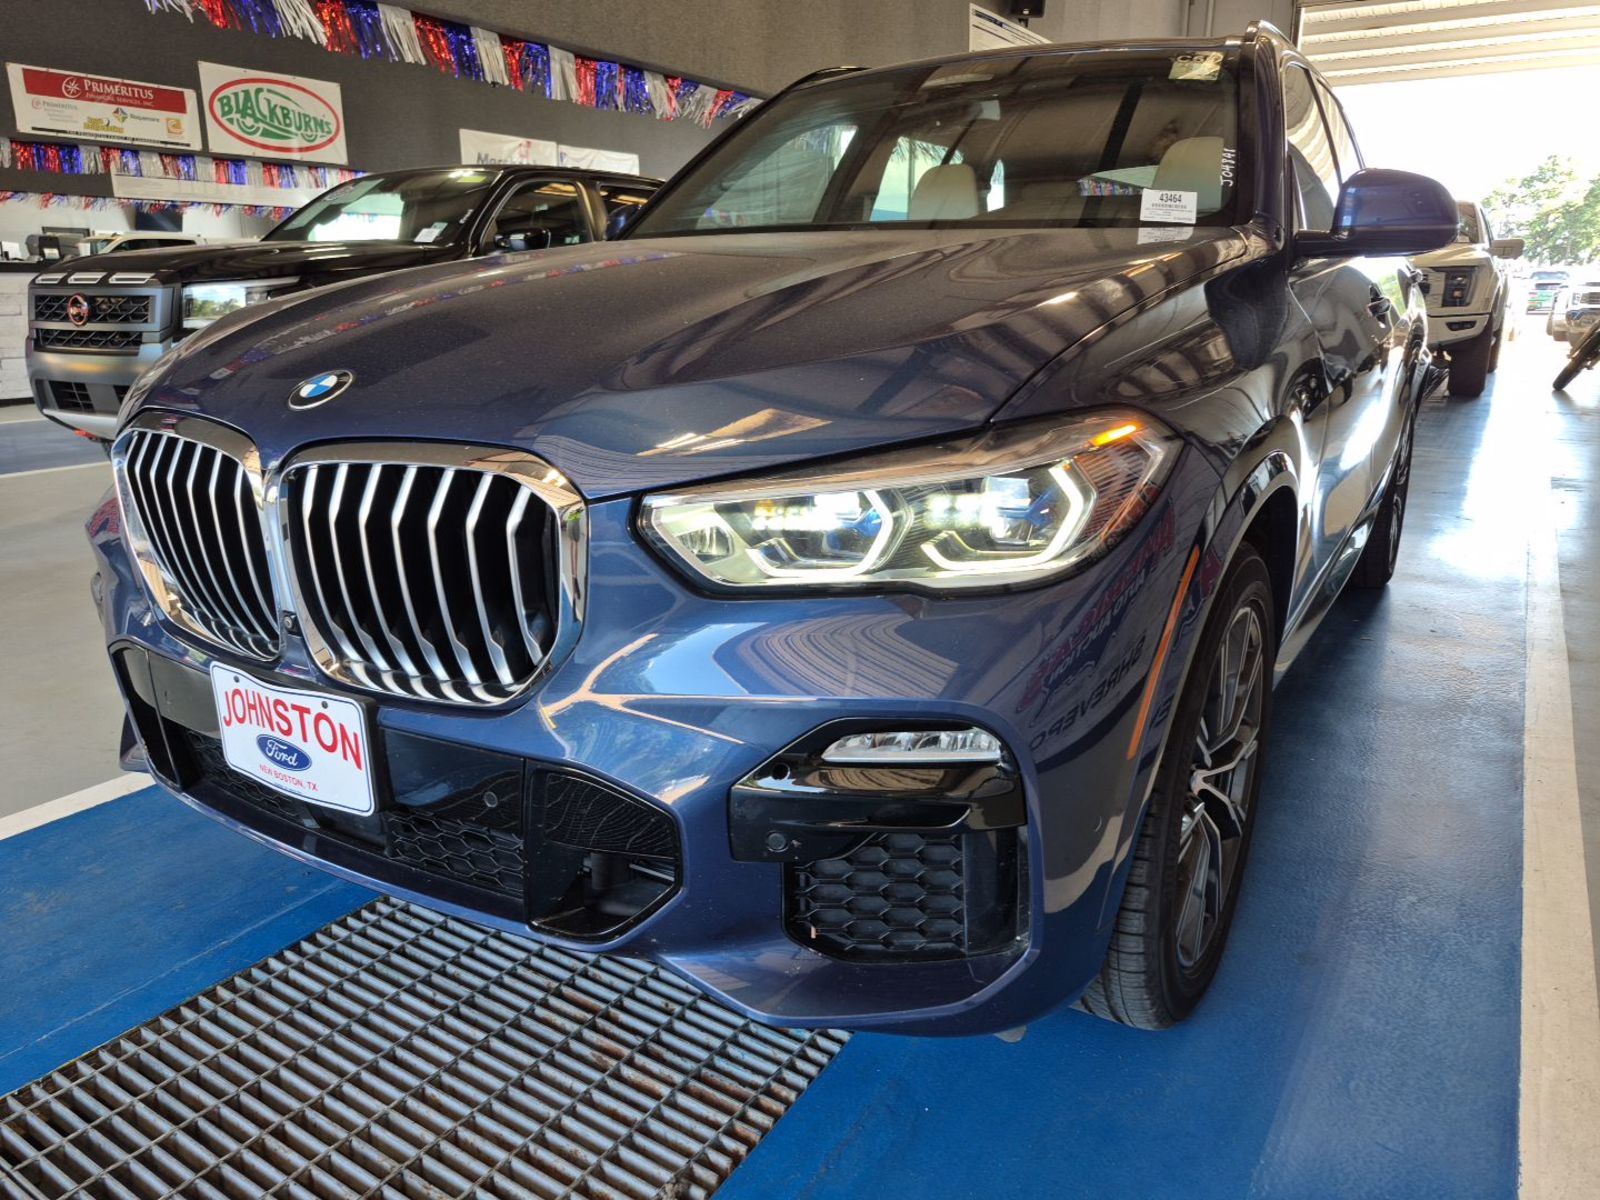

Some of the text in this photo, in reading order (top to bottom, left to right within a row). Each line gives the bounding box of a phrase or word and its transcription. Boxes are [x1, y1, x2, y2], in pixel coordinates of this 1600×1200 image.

[83, 79, 154, 99] PRIMERITUS
[1159, 192, 1182, 203] 43464
[223, 688, 362, 771] JOHNSTON
[265, 739, 298, 767] Ford
[307, 781, 319, 792] TX
